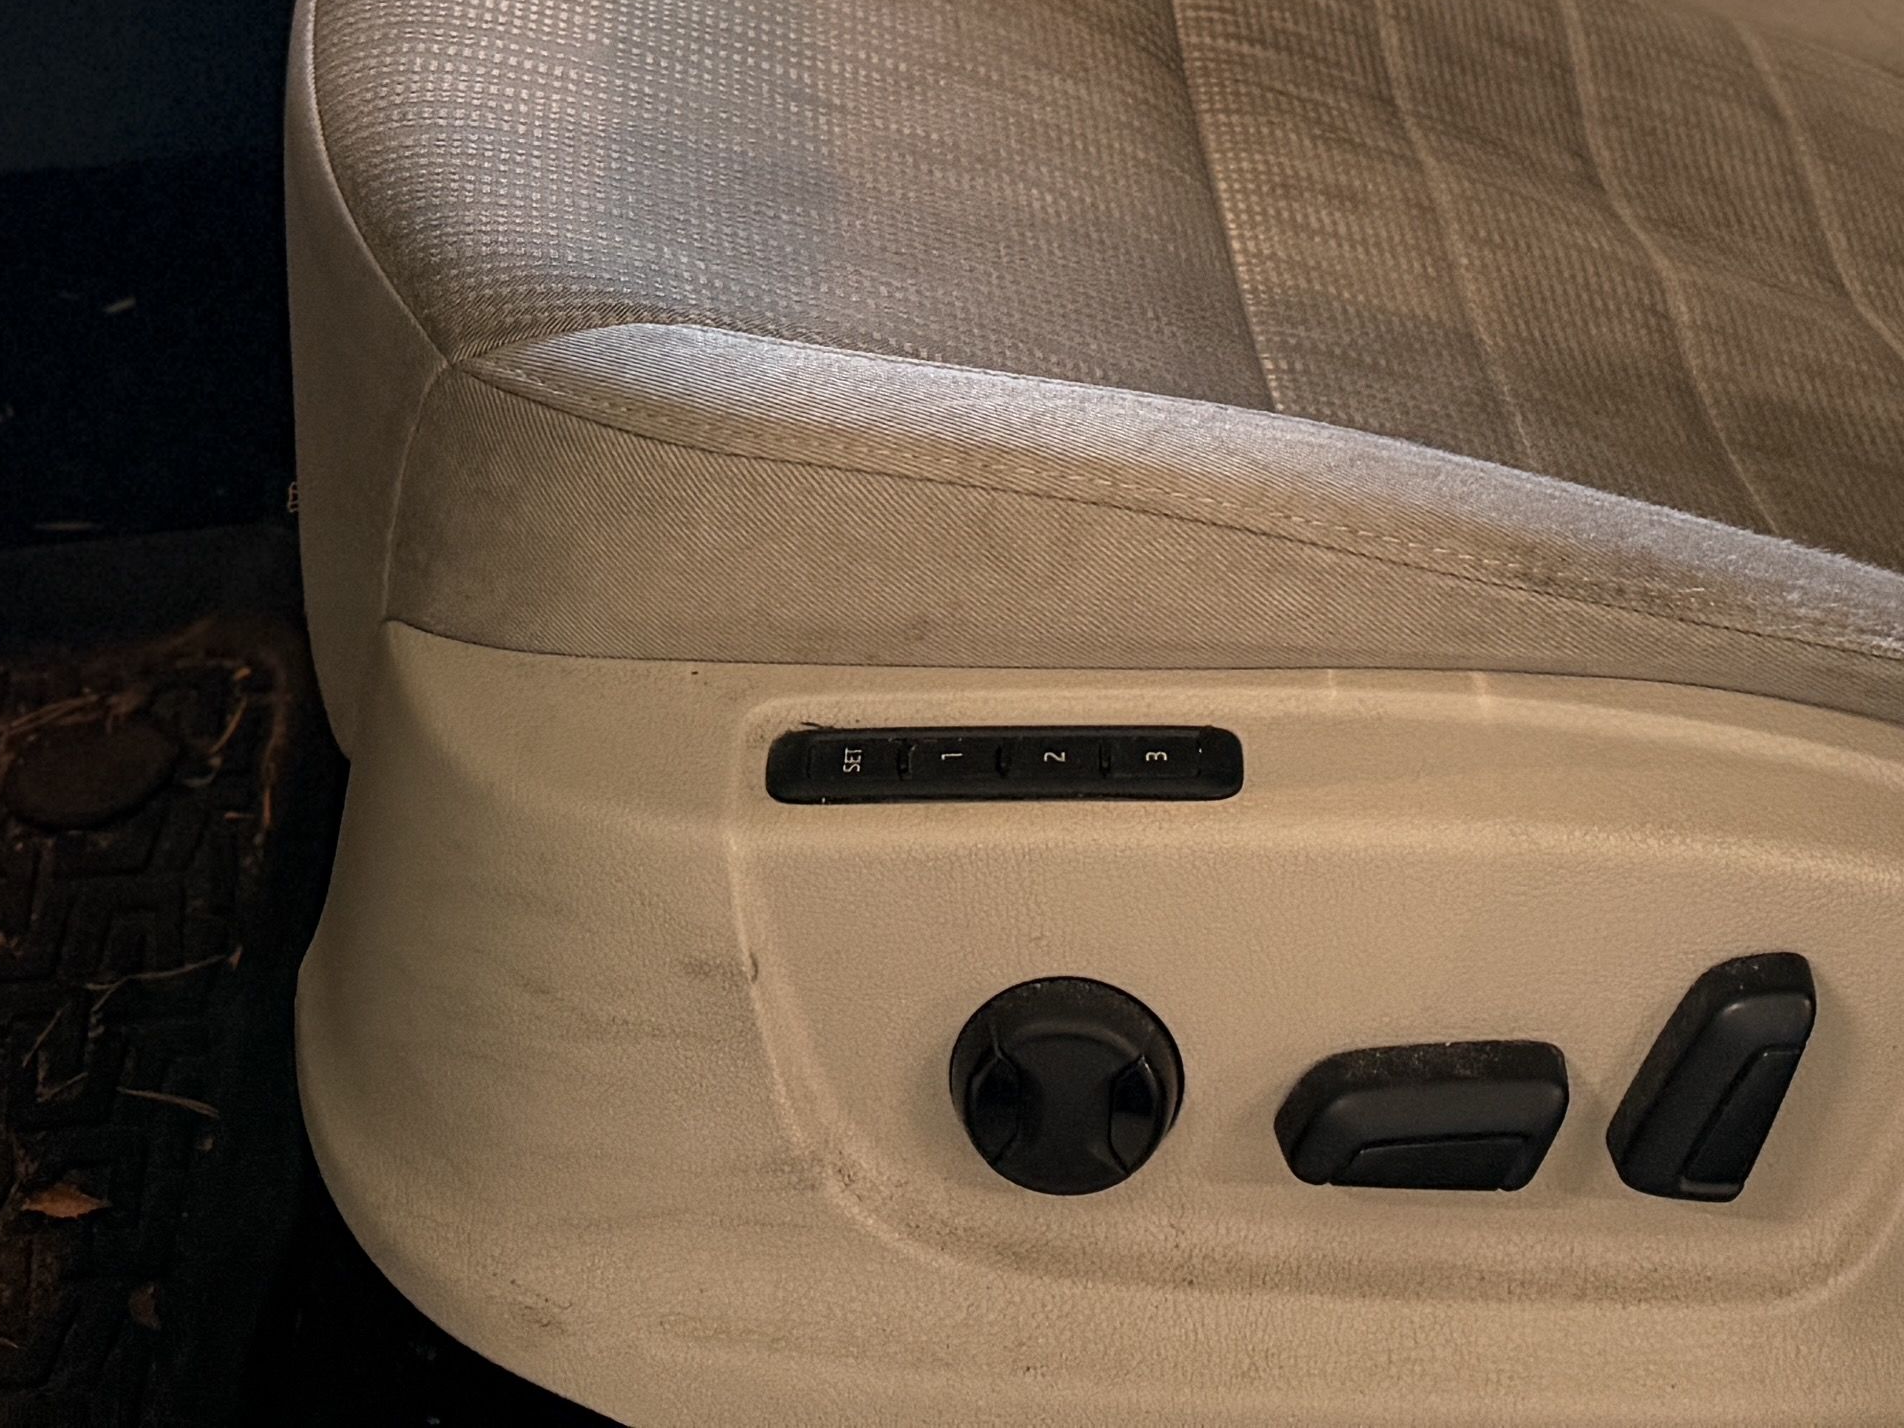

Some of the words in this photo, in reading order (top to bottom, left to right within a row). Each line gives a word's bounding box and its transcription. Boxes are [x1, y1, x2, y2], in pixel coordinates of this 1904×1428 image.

[843, 747, 861, 773] SET
[941, 752, 963, 761] 1
[1044, 750, 1066, 763] 2
[1146, 750, 1168, 762] 3
